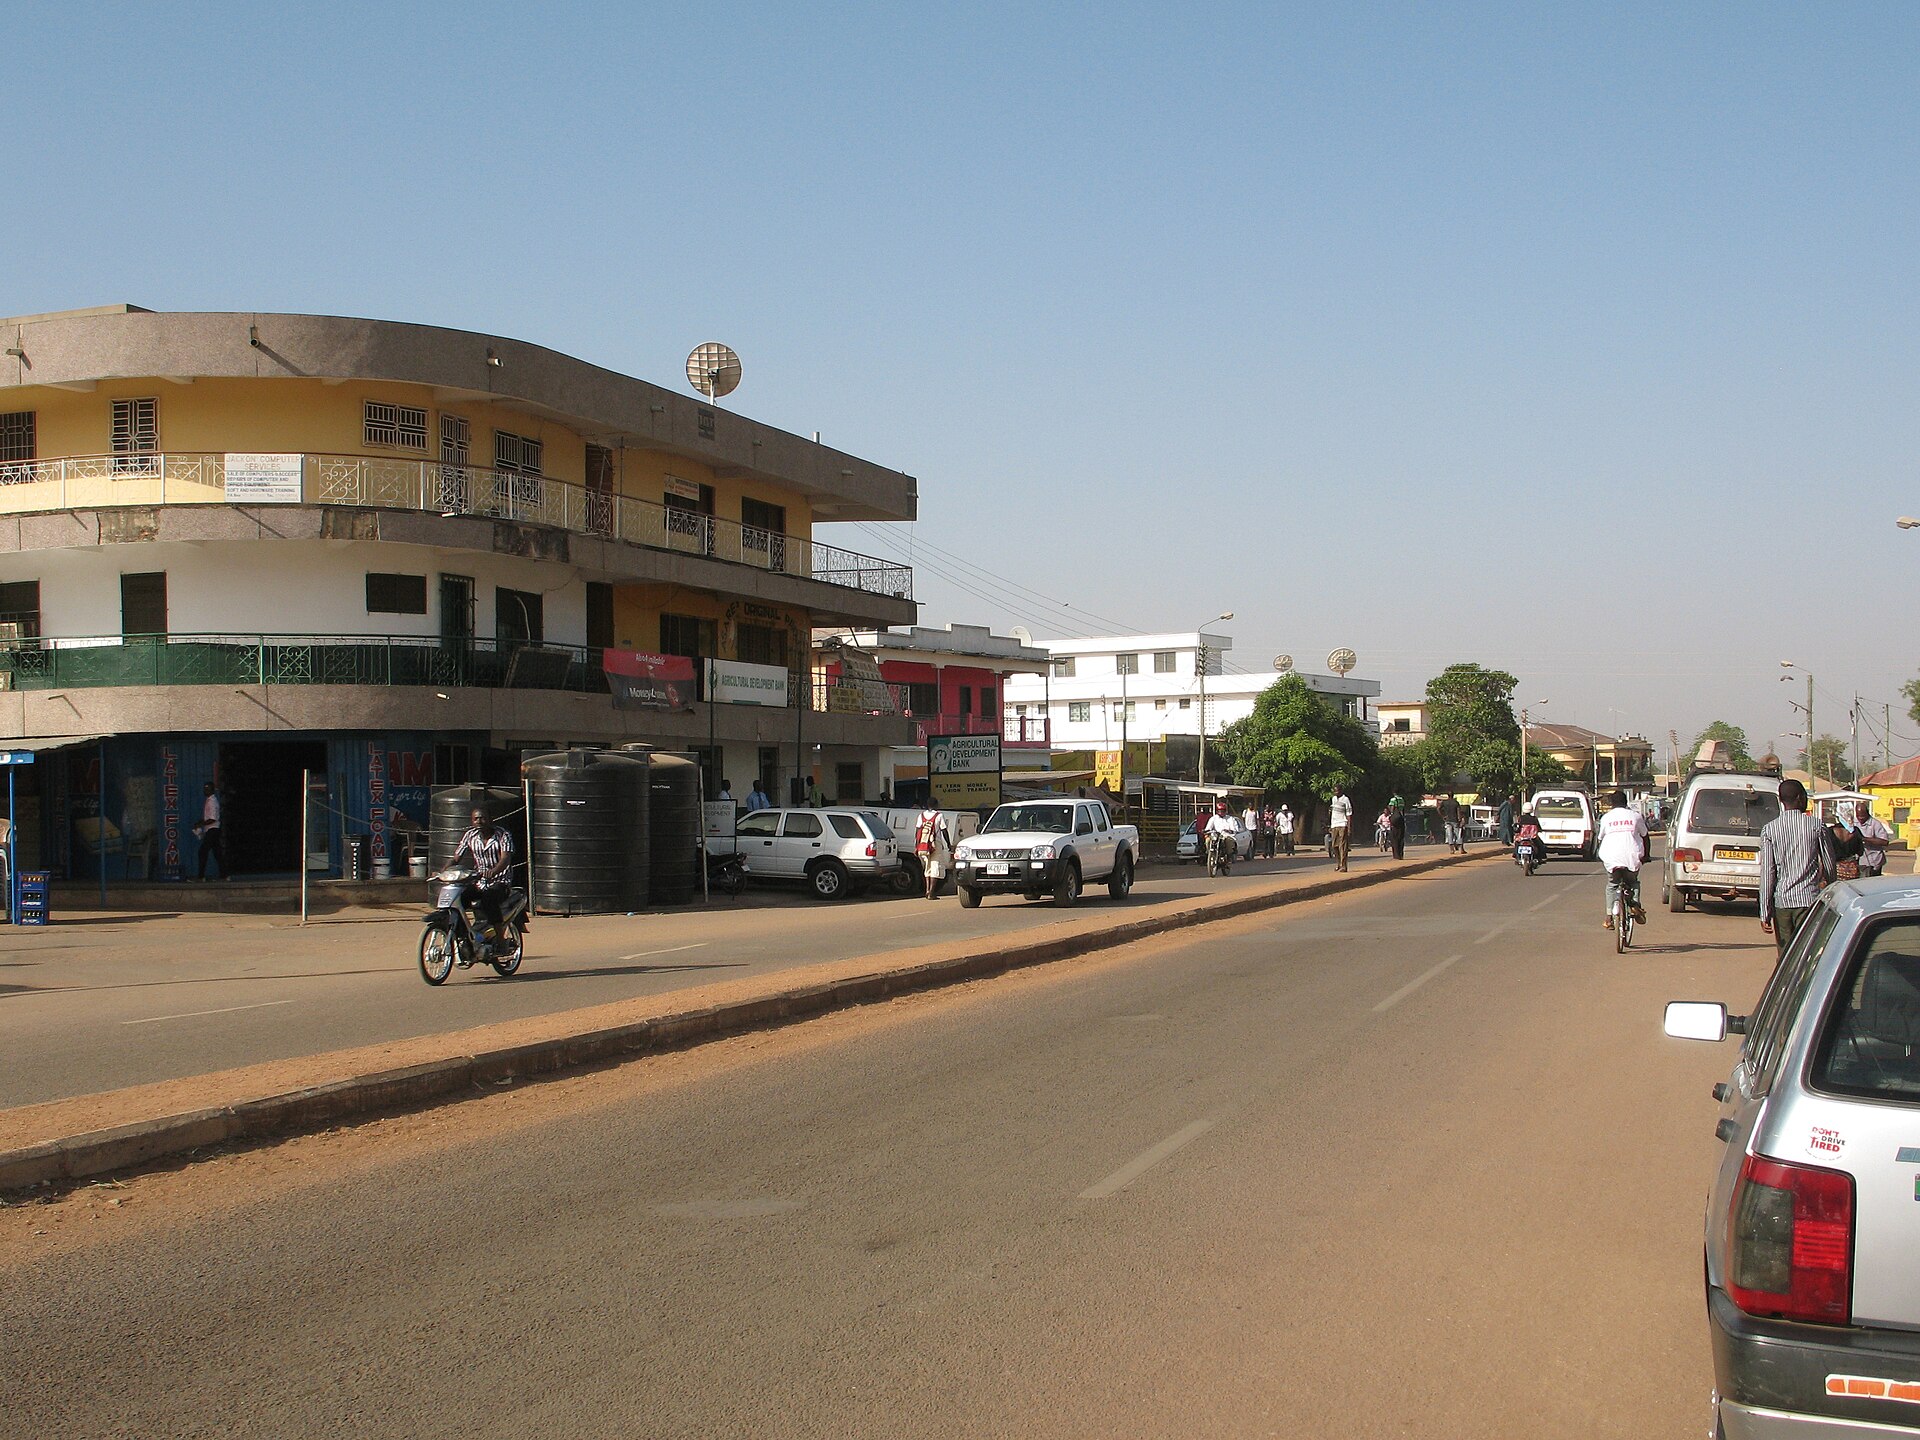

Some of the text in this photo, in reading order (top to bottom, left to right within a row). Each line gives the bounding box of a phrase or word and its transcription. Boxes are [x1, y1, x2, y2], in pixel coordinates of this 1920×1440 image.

[721, 674, 786, 690] AGRICULTURAL DEVELOPMENT BANK
[952, 739, 999, 749] AGRICULTURAL
[952, 749, 997, 759] DEVELOPMENT
[952, 759, 970, 768] BANK
[368, 741, 386, 857] LATEX FOAM
[162, 746, 179, 865] LATEX FOAM
[1609, 819, 1634, 827] TOTAL
[1812, 1127, 1840, 1138] DON'T
[1810, 1136, 1840, 1152] TIRED
[1821, 1136, 1845, 1145] DRIVE
